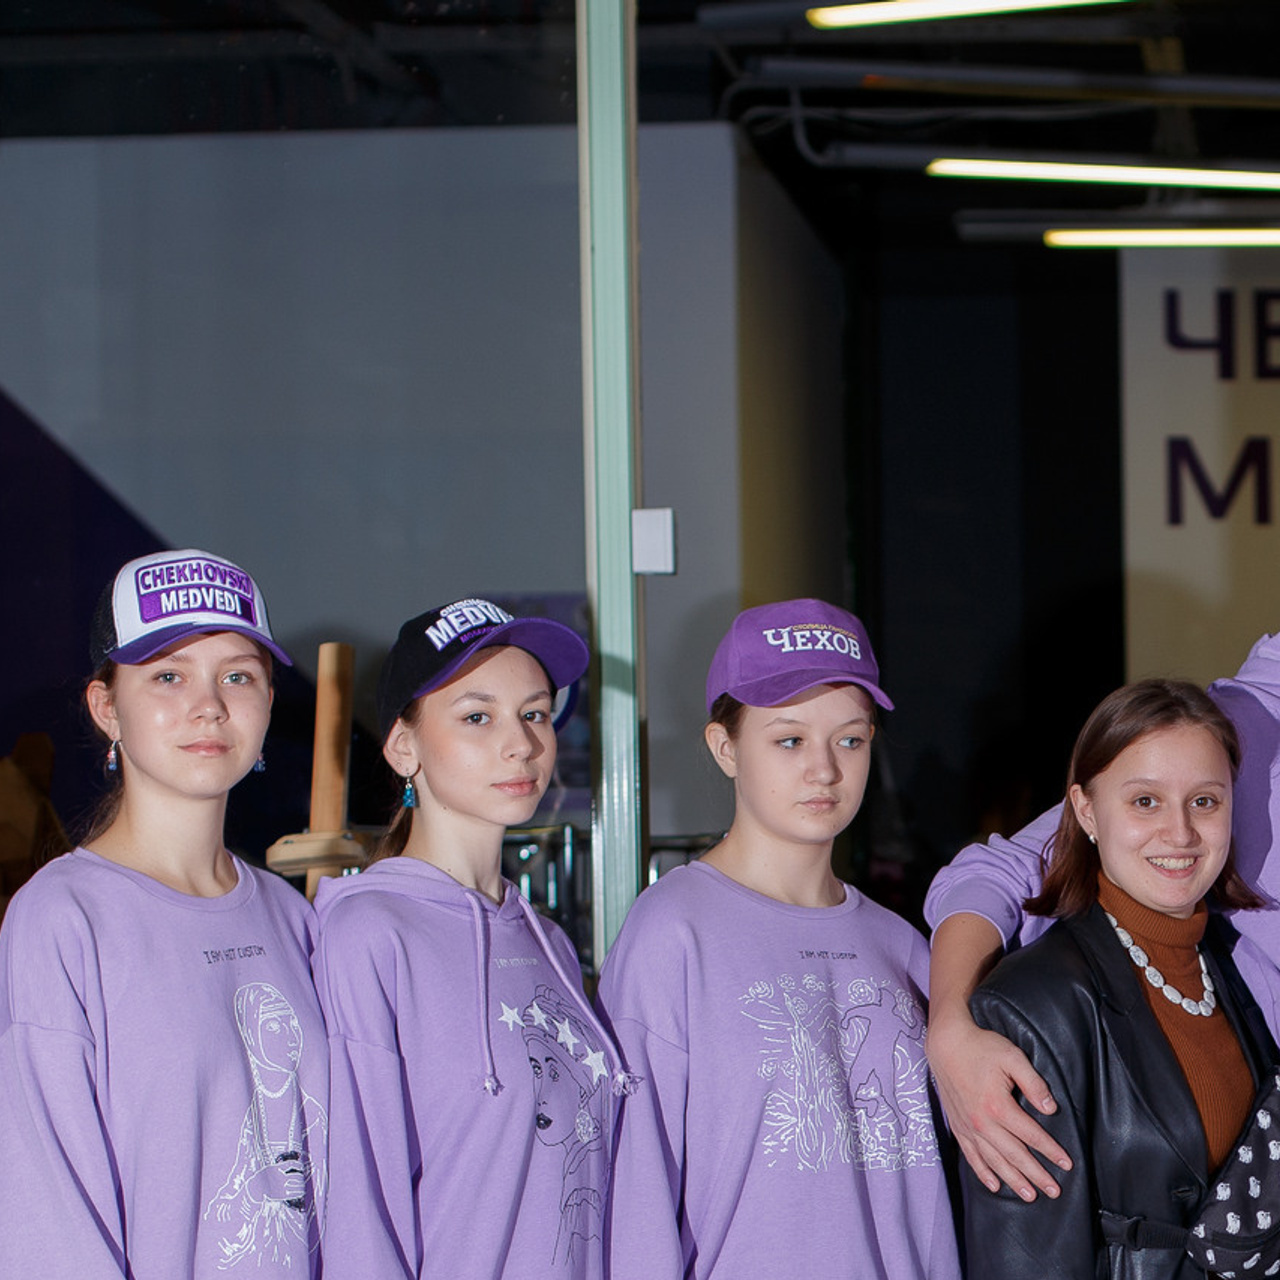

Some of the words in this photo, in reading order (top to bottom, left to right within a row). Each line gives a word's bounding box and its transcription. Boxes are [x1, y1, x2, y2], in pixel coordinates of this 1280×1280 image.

[140, 562, 252, 596] CHEKHOVSKI
[160, 586, 242, 615] MEDVEDI
[762, 625, 862, 660] ЧЕХОВ
[237, 944, 267, 959] CUSTOM
